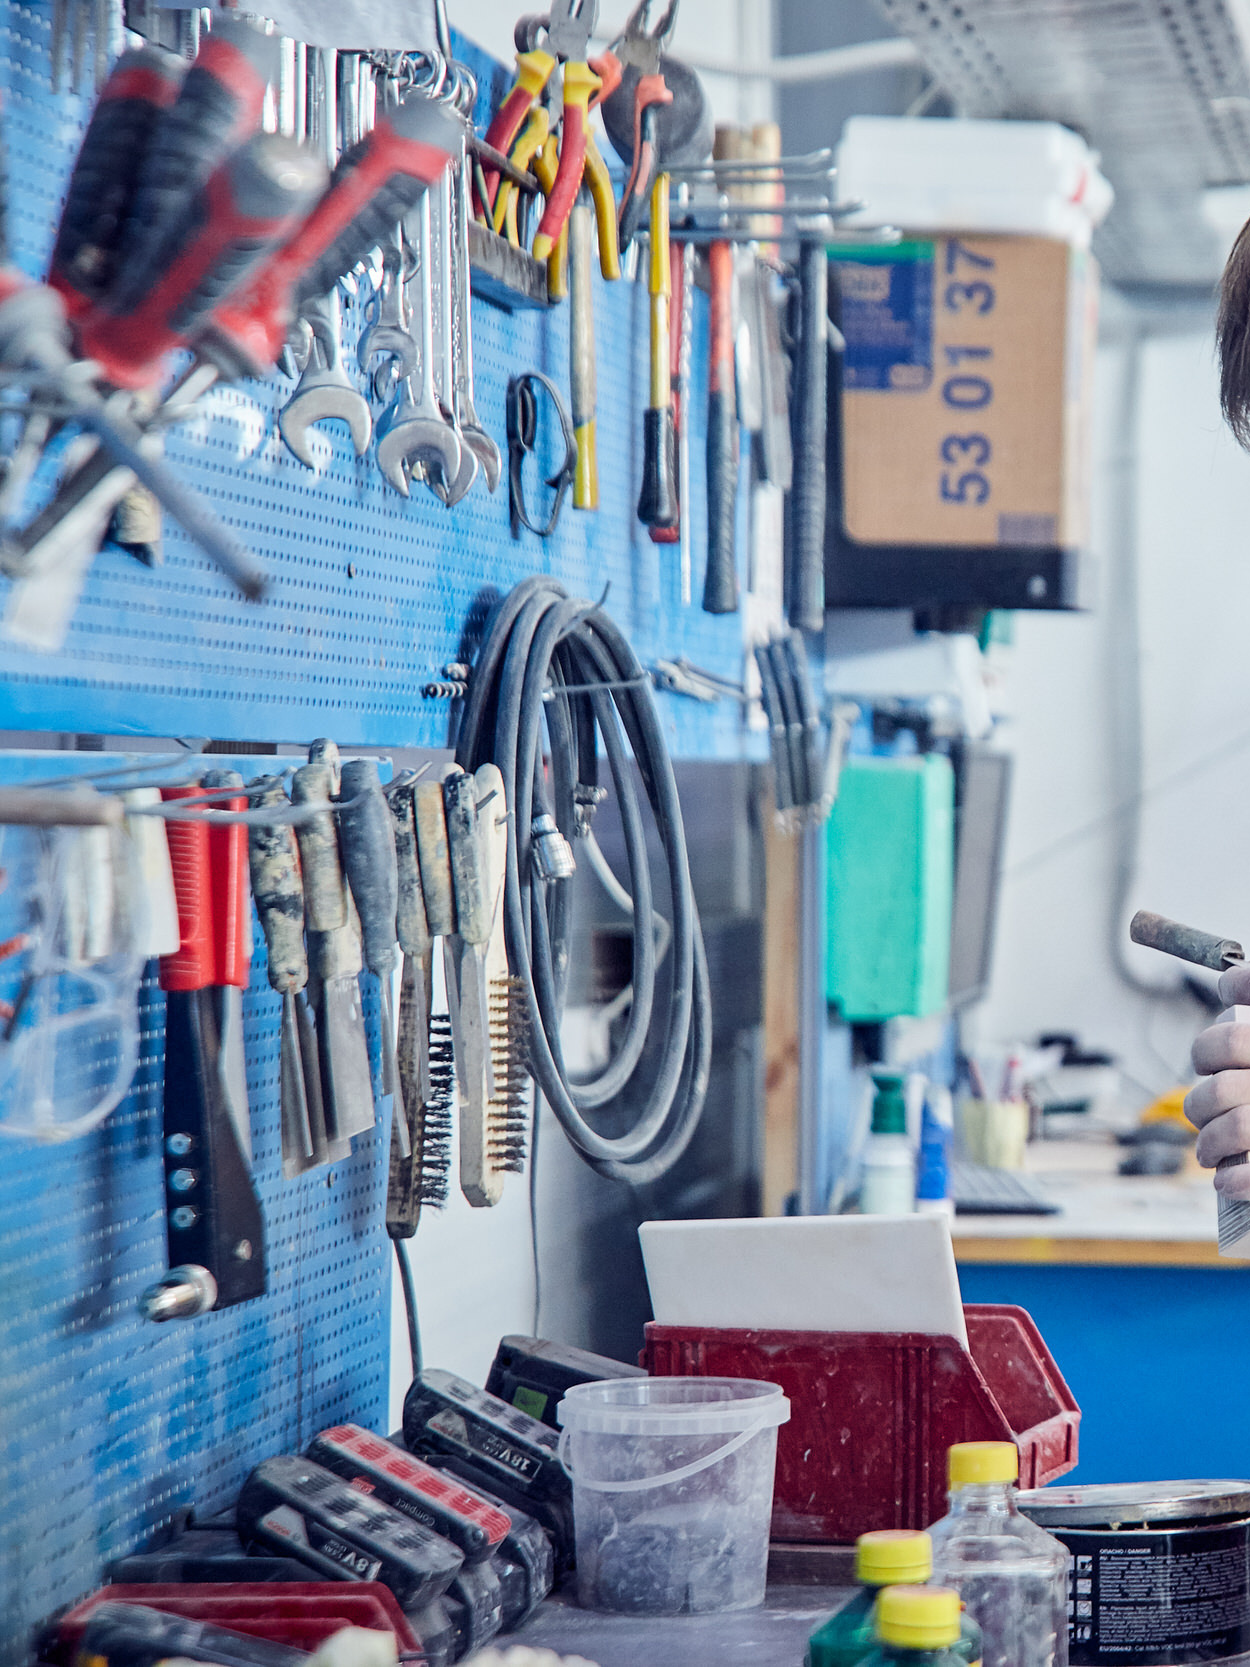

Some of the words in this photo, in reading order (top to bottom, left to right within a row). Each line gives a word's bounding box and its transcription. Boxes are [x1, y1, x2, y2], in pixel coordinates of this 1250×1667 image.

[944, 236, 996, 317] 37
[941, 345, 995, 411] 01
[939, 431, 993, 506] 53
[499, 1448, 530, 1471] 18V
[395, 1496, 436, 1528] Compact
